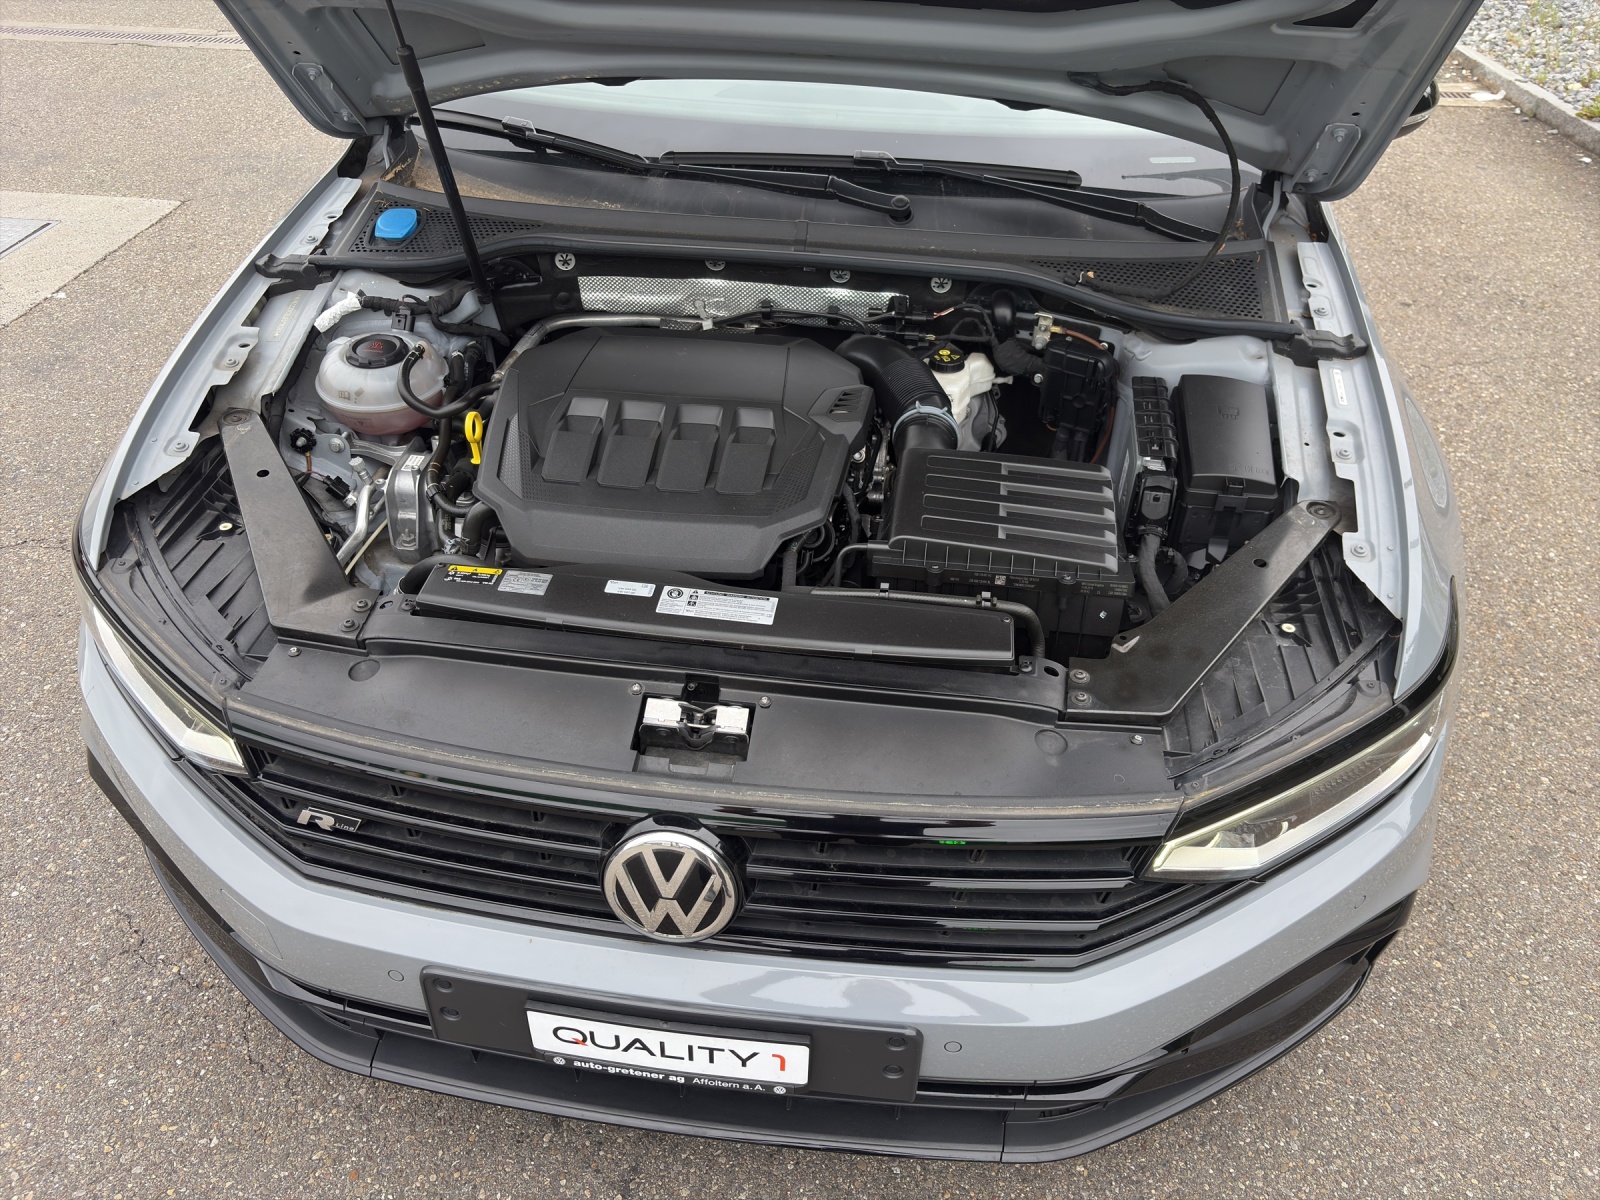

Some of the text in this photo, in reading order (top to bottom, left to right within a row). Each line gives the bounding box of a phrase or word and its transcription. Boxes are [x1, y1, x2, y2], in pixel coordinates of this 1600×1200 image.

[552, 1026, 786, 1072] QUALITY 1
[573, 1060, 665, 1080] auto-gretener
[668, 1075, 685, 1083] ag
[692, 1077, 740, 1089] Affoltern
